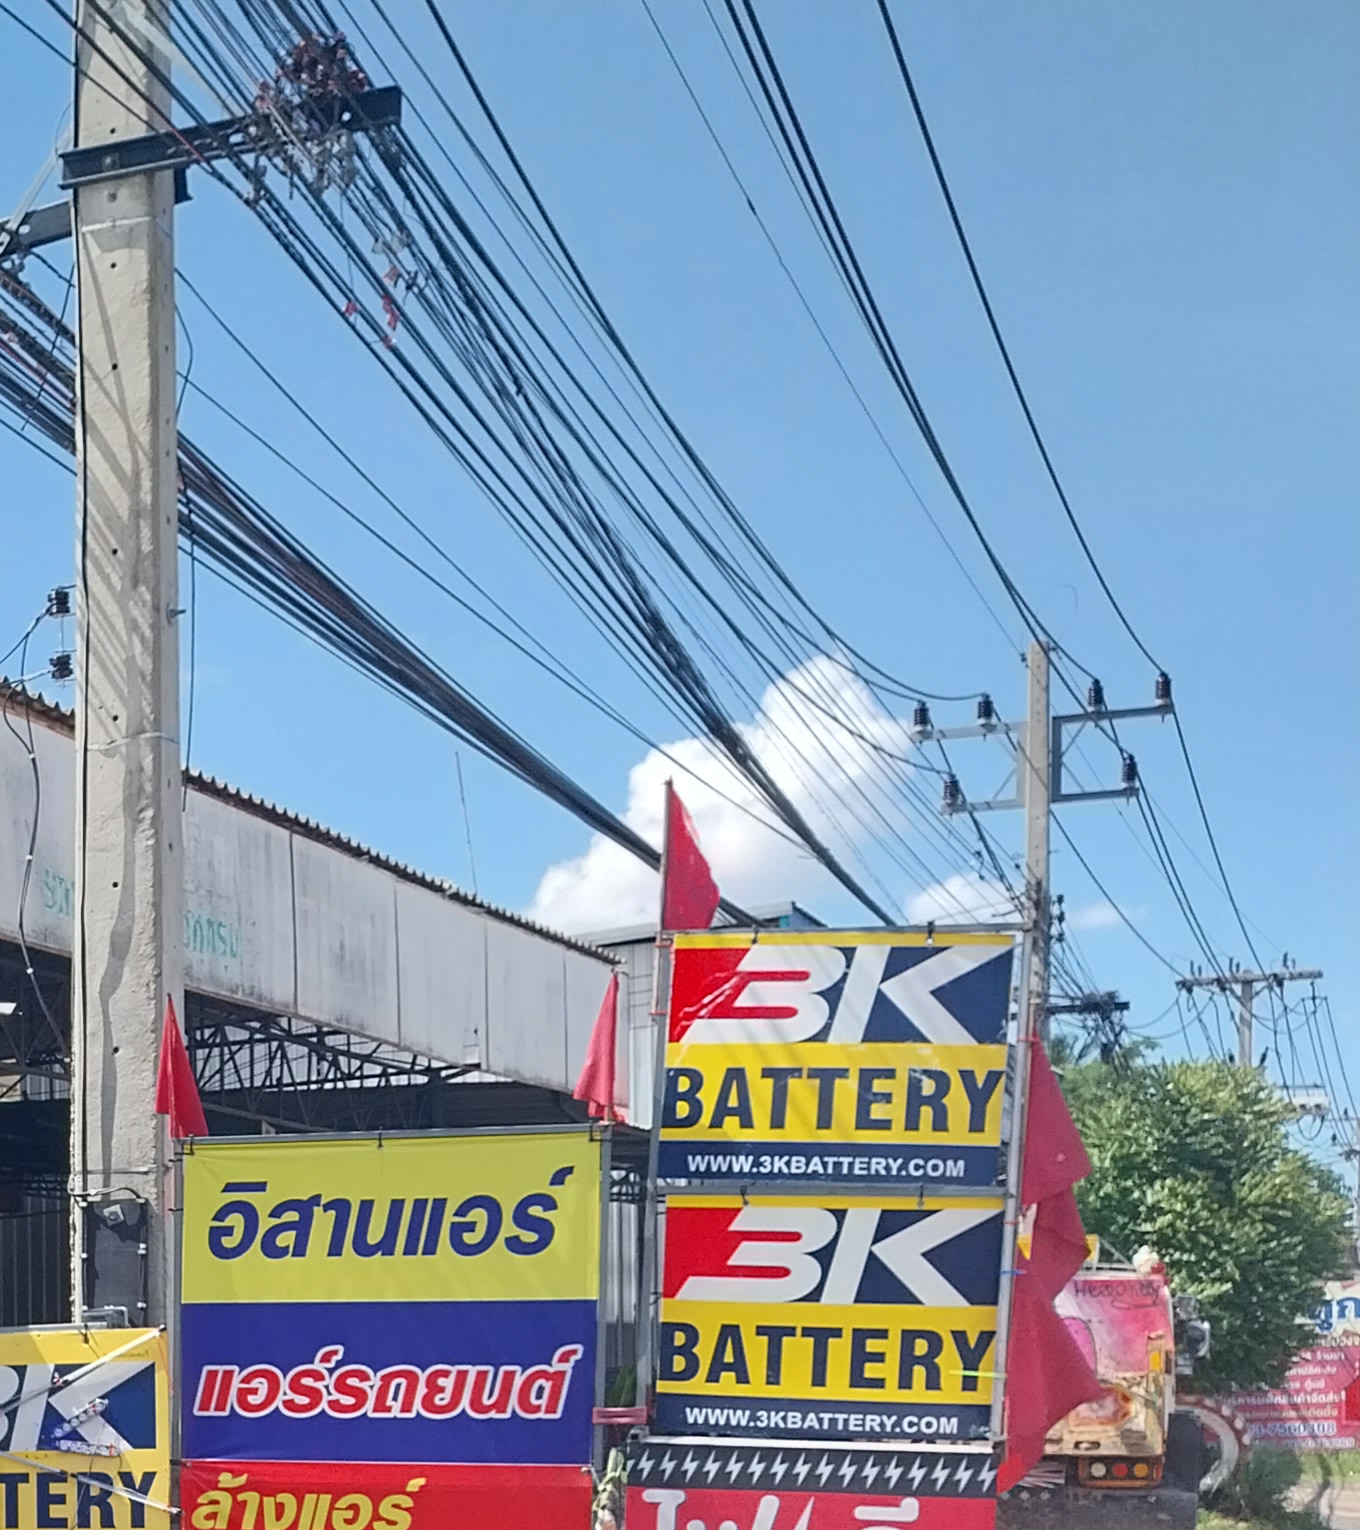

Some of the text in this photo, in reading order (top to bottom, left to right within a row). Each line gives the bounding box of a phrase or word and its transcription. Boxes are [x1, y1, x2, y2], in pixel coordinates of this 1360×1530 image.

[680, 943, 1016, 1044] 3K
[661, 1066, 1006, 1133] BATTERY
[687, 1154, 966, 1178] WWW.3KBATTERY.COM
[208, 1165, 575, 1260] อิสานแอร์
[675, 1208, 1006, 1307] 3K
[194, 1344, 583, 1420] แอร์รถยนต์
[658, 1321, 997, 1393] BATTERY
[685, 1408, 959, 1434] WWW.3KBATTERY.COM
